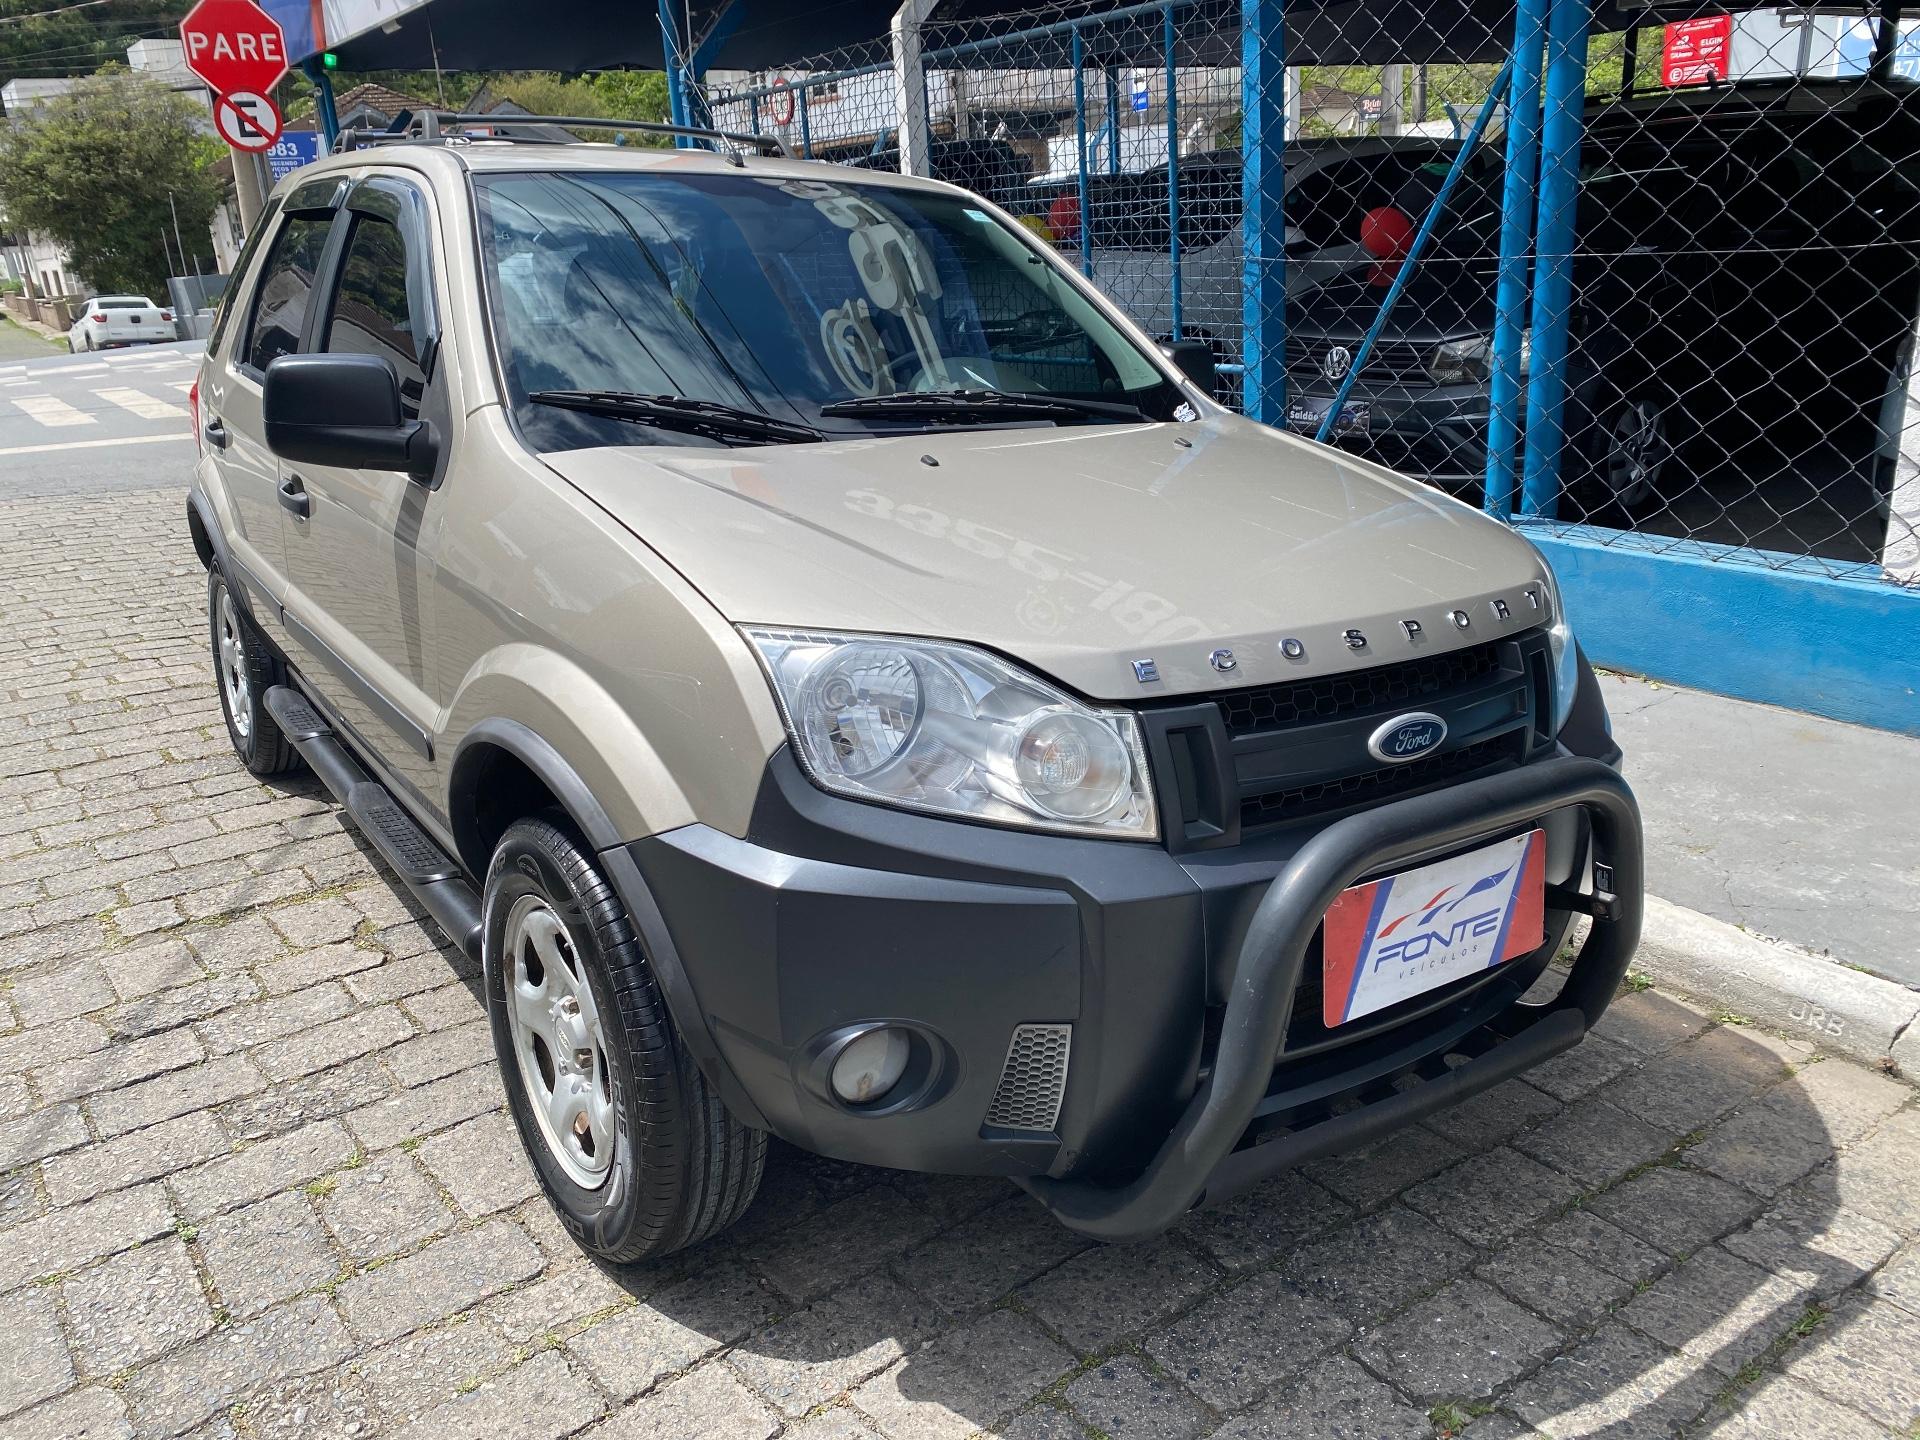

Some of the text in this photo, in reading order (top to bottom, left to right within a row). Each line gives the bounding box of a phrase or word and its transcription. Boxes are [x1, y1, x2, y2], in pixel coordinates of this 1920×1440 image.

[187, 31, 282, 61] PARE
[233, 101, 263, 138] E
[1289, 410, 1319, 422] Saldão
[1130, 589, 1539, 683] ECOSPORT
[1394, 723, 1433, 754] Ford
[1374, 907, 1501, 973] FONTE
